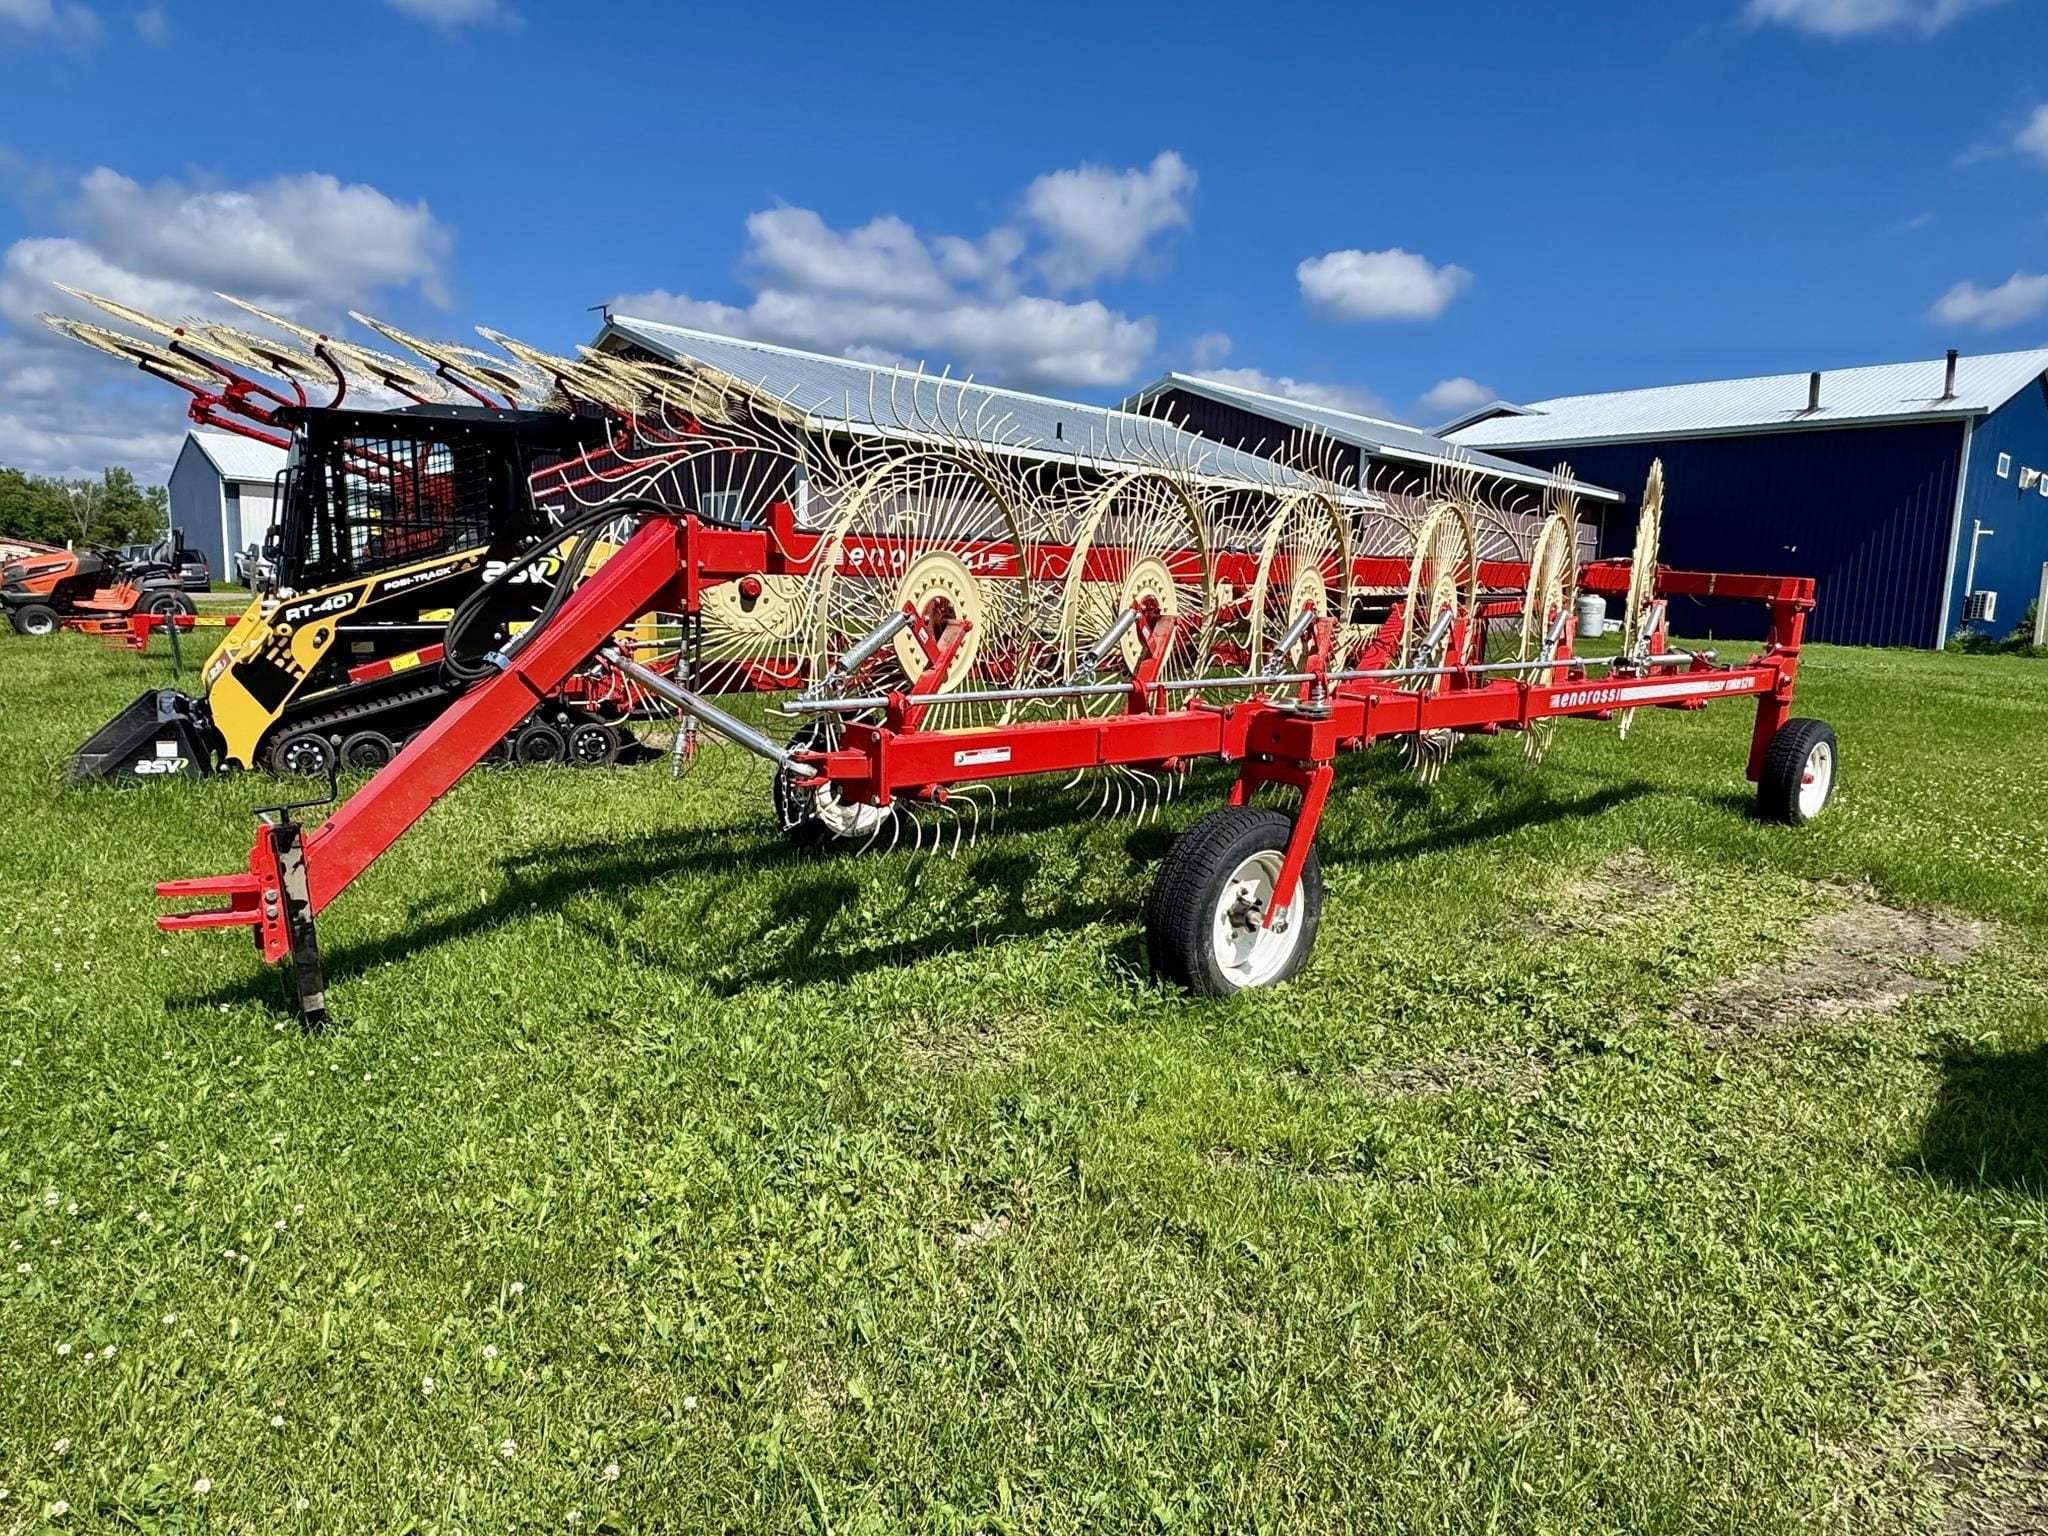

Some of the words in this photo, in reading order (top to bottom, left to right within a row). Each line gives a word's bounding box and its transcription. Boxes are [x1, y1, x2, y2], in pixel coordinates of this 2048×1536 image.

[384, 568, 451, 591] POSI-TRACK
[285, 594, 348, 622] RT-40
[1560, 688, 1621, 708] enorossi
[134, 759, 180, 773] asv
